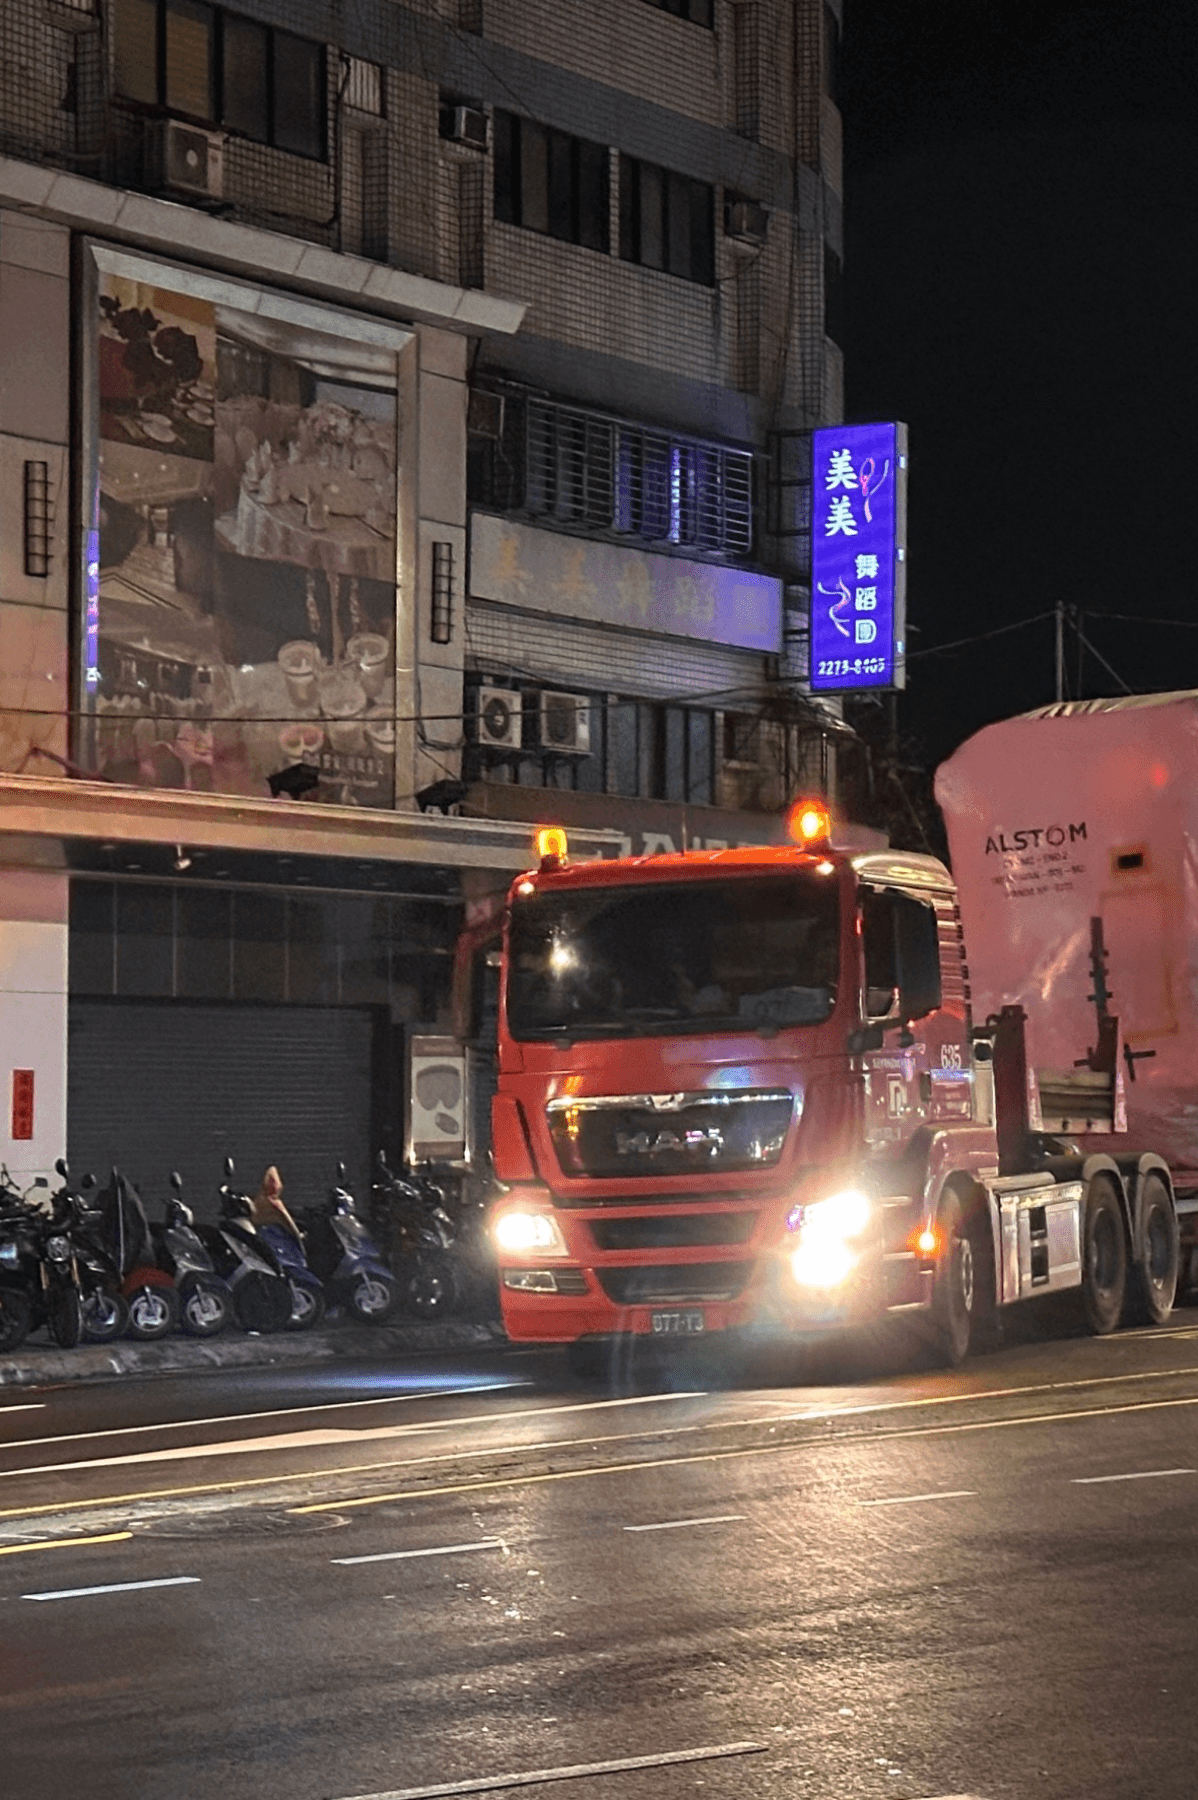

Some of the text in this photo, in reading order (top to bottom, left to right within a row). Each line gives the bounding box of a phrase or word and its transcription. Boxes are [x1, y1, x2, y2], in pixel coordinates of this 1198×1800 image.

[825, 448, 858, 537] 美美
[985, 822, 1088, 855] ALSTOM
[940, 1044, 961, 1070] 635
